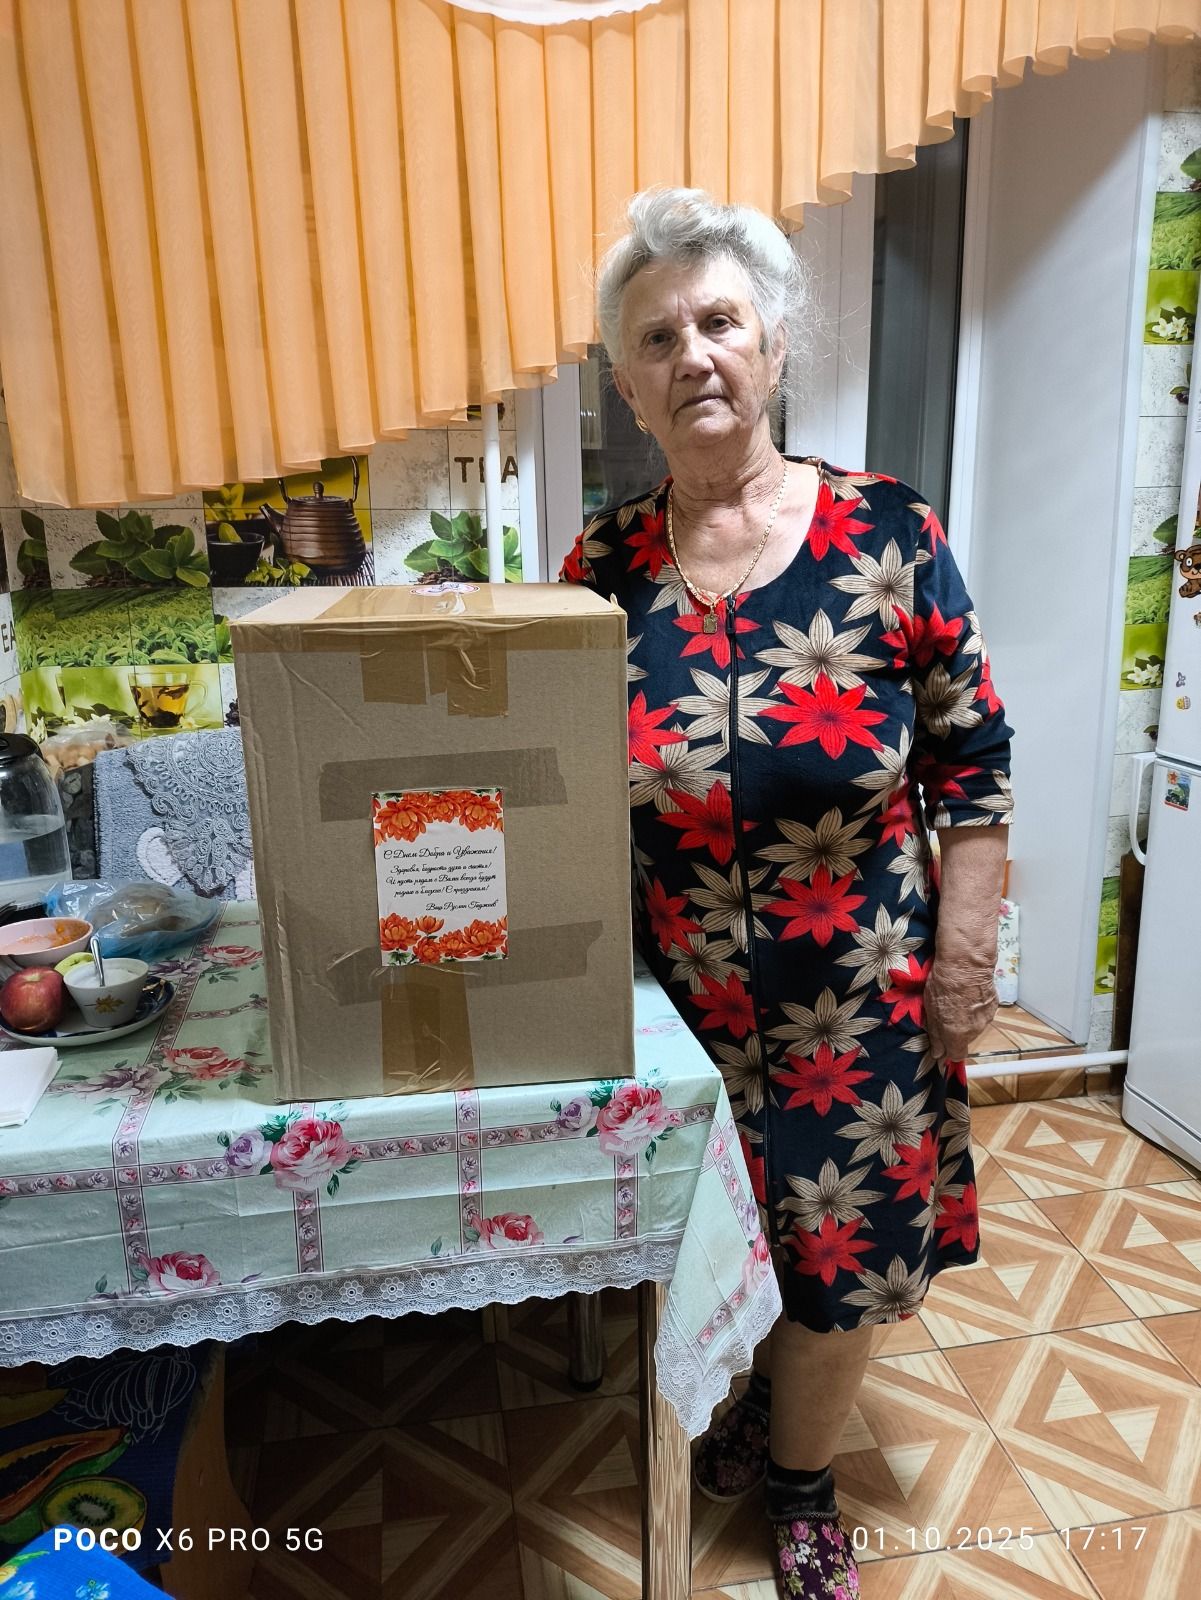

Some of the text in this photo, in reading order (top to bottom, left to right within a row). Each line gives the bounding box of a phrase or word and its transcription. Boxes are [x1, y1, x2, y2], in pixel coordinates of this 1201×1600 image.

[383, 849, 393, 860] С
[393, 849, 418, 859] Днем
[419, 846, 445, 859] Добра
[453, 845, 498, 860] Уважения!
[447, 865, 462, 873] духа
[385, 876, 396, 885] И
[438, 874, 459, 882] Вами
[478, 872, 496, 882] будут
[445, 884, 453, 894] С
